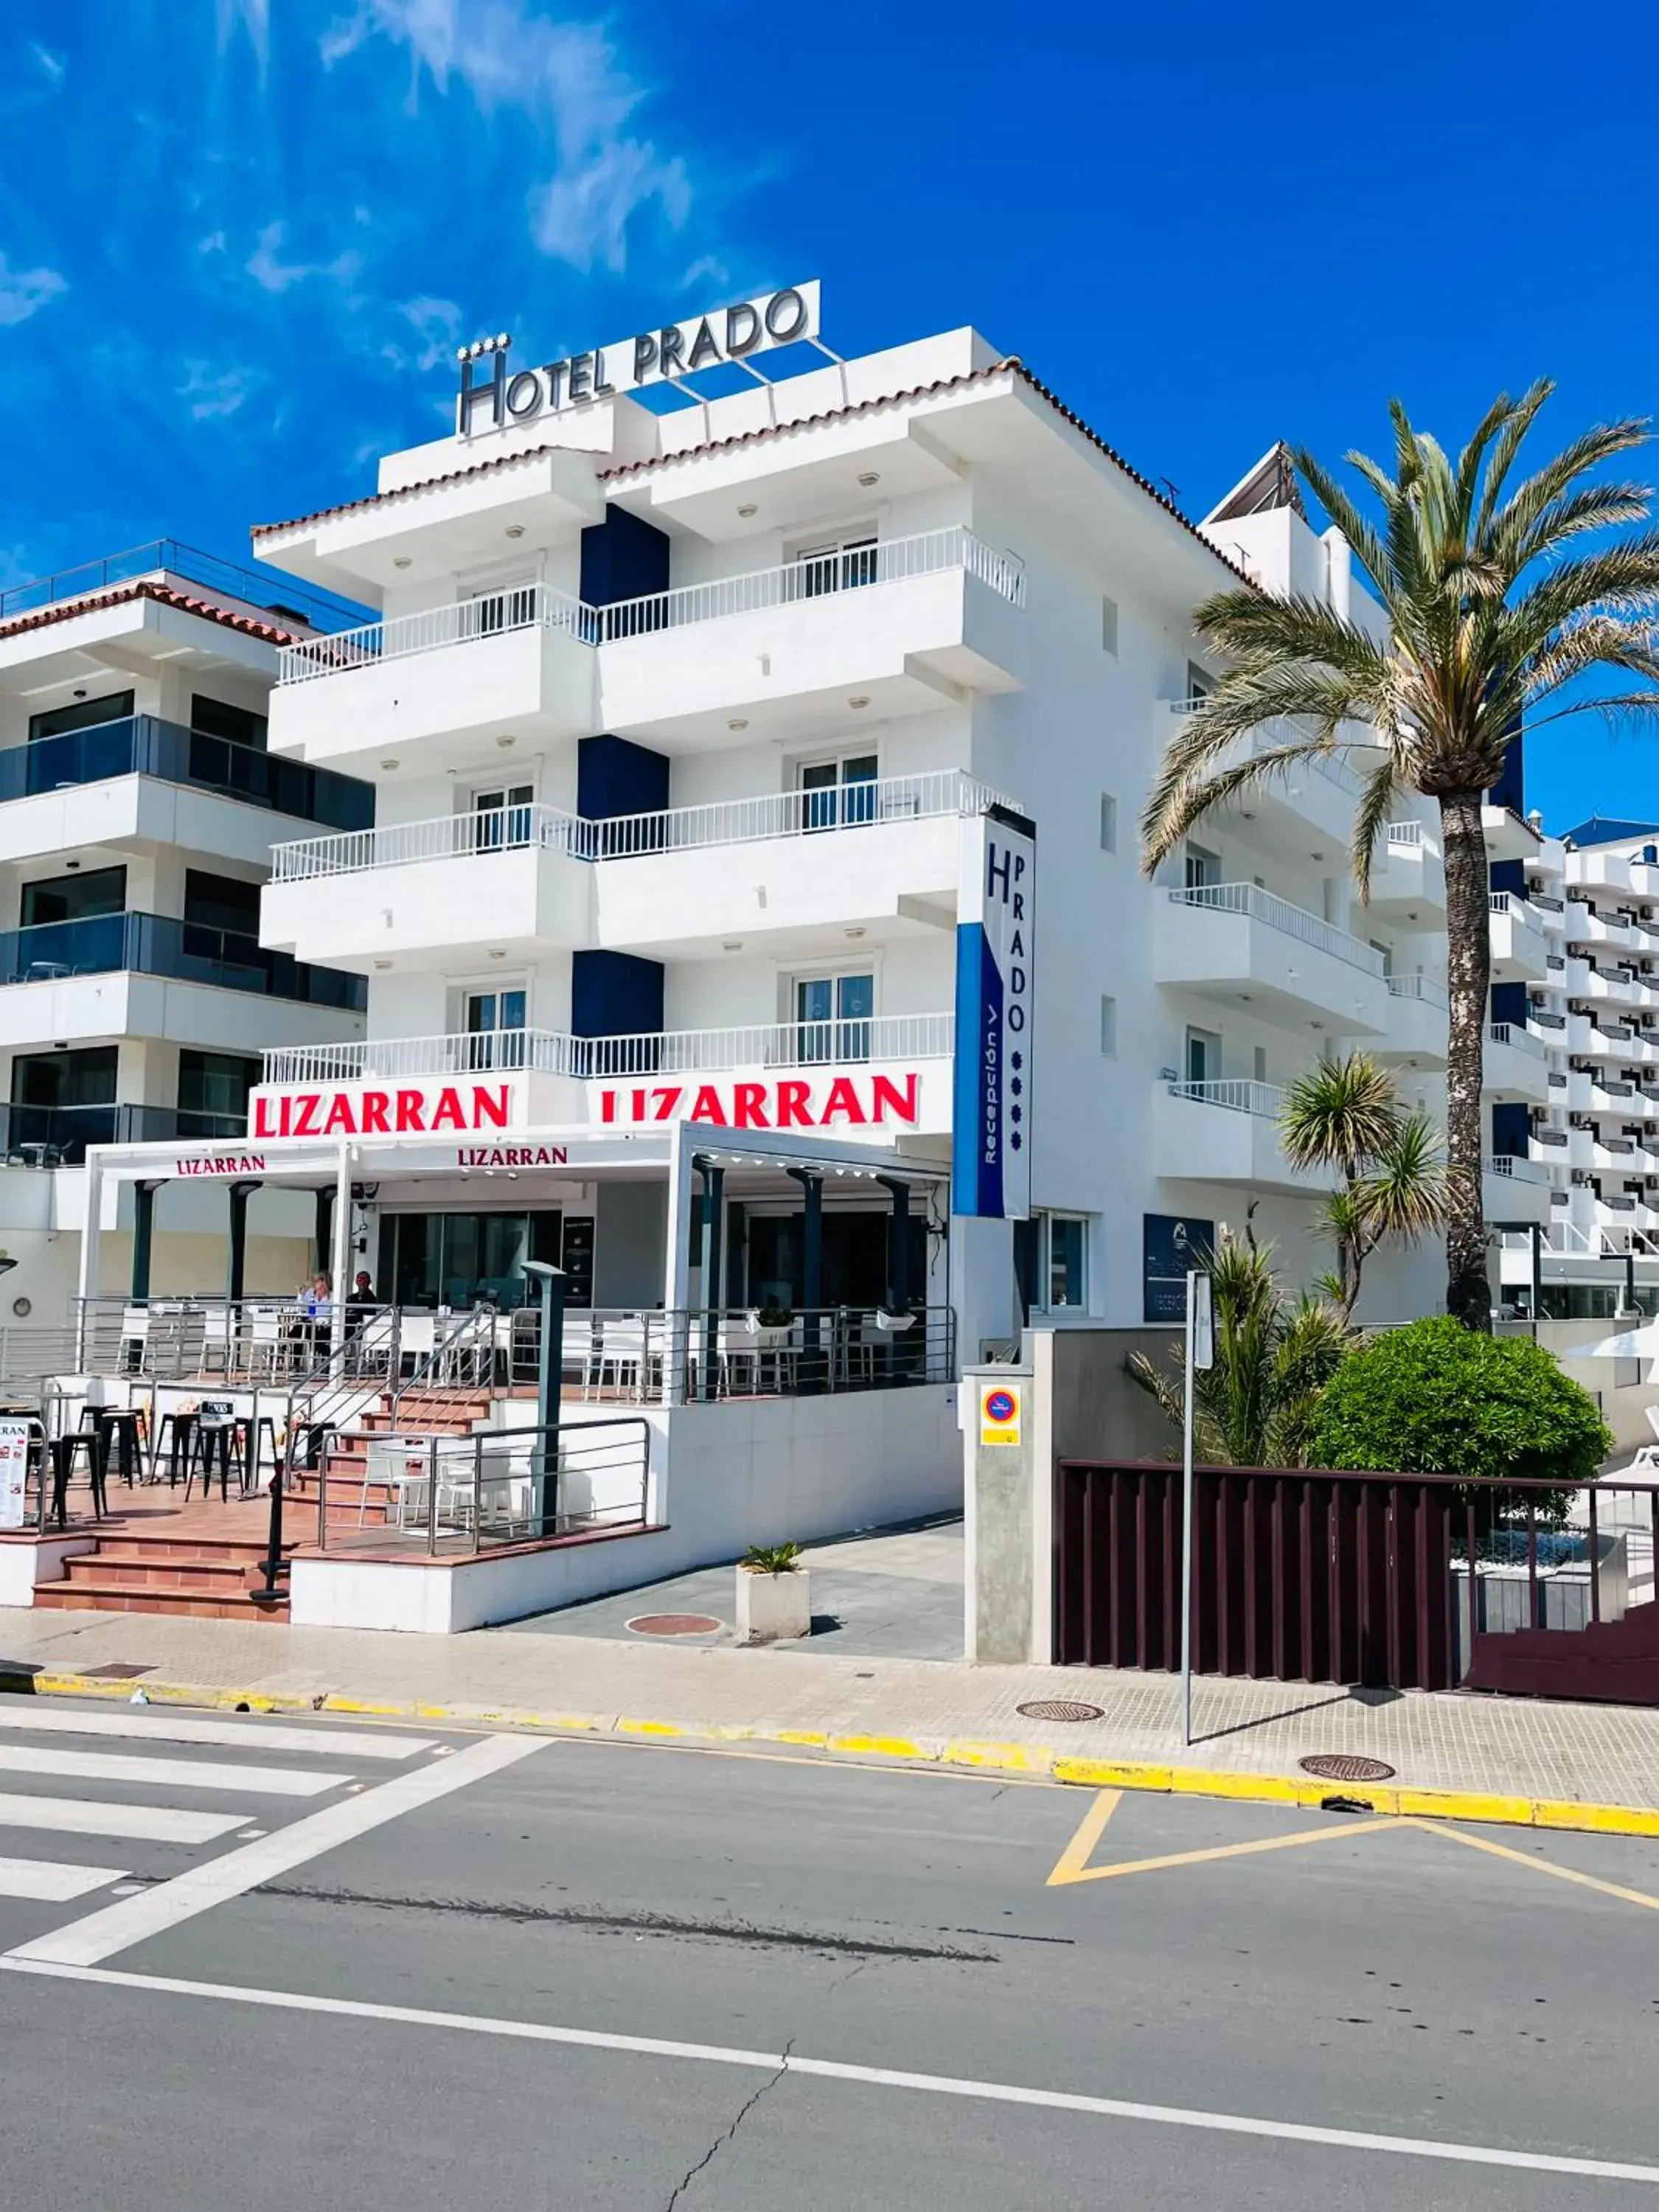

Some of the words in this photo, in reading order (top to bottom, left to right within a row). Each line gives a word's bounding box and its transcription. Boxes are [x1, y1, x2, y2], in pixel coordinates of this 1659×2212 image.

[459, 349, 613, 435] HOTEL
[634, 288, 807, 383] PRADO
[987, 842, 1011, 905] H
[1008, 854, 1026, 1033] PRADO
[254, 1085, 509, 1138] LIZARRAN
[984, 1032, 998, 1164] Recepción
[176, 1154, 266, 1176] LIZARRAN
[457, 1146, 568, 1166] LIZARRAN
